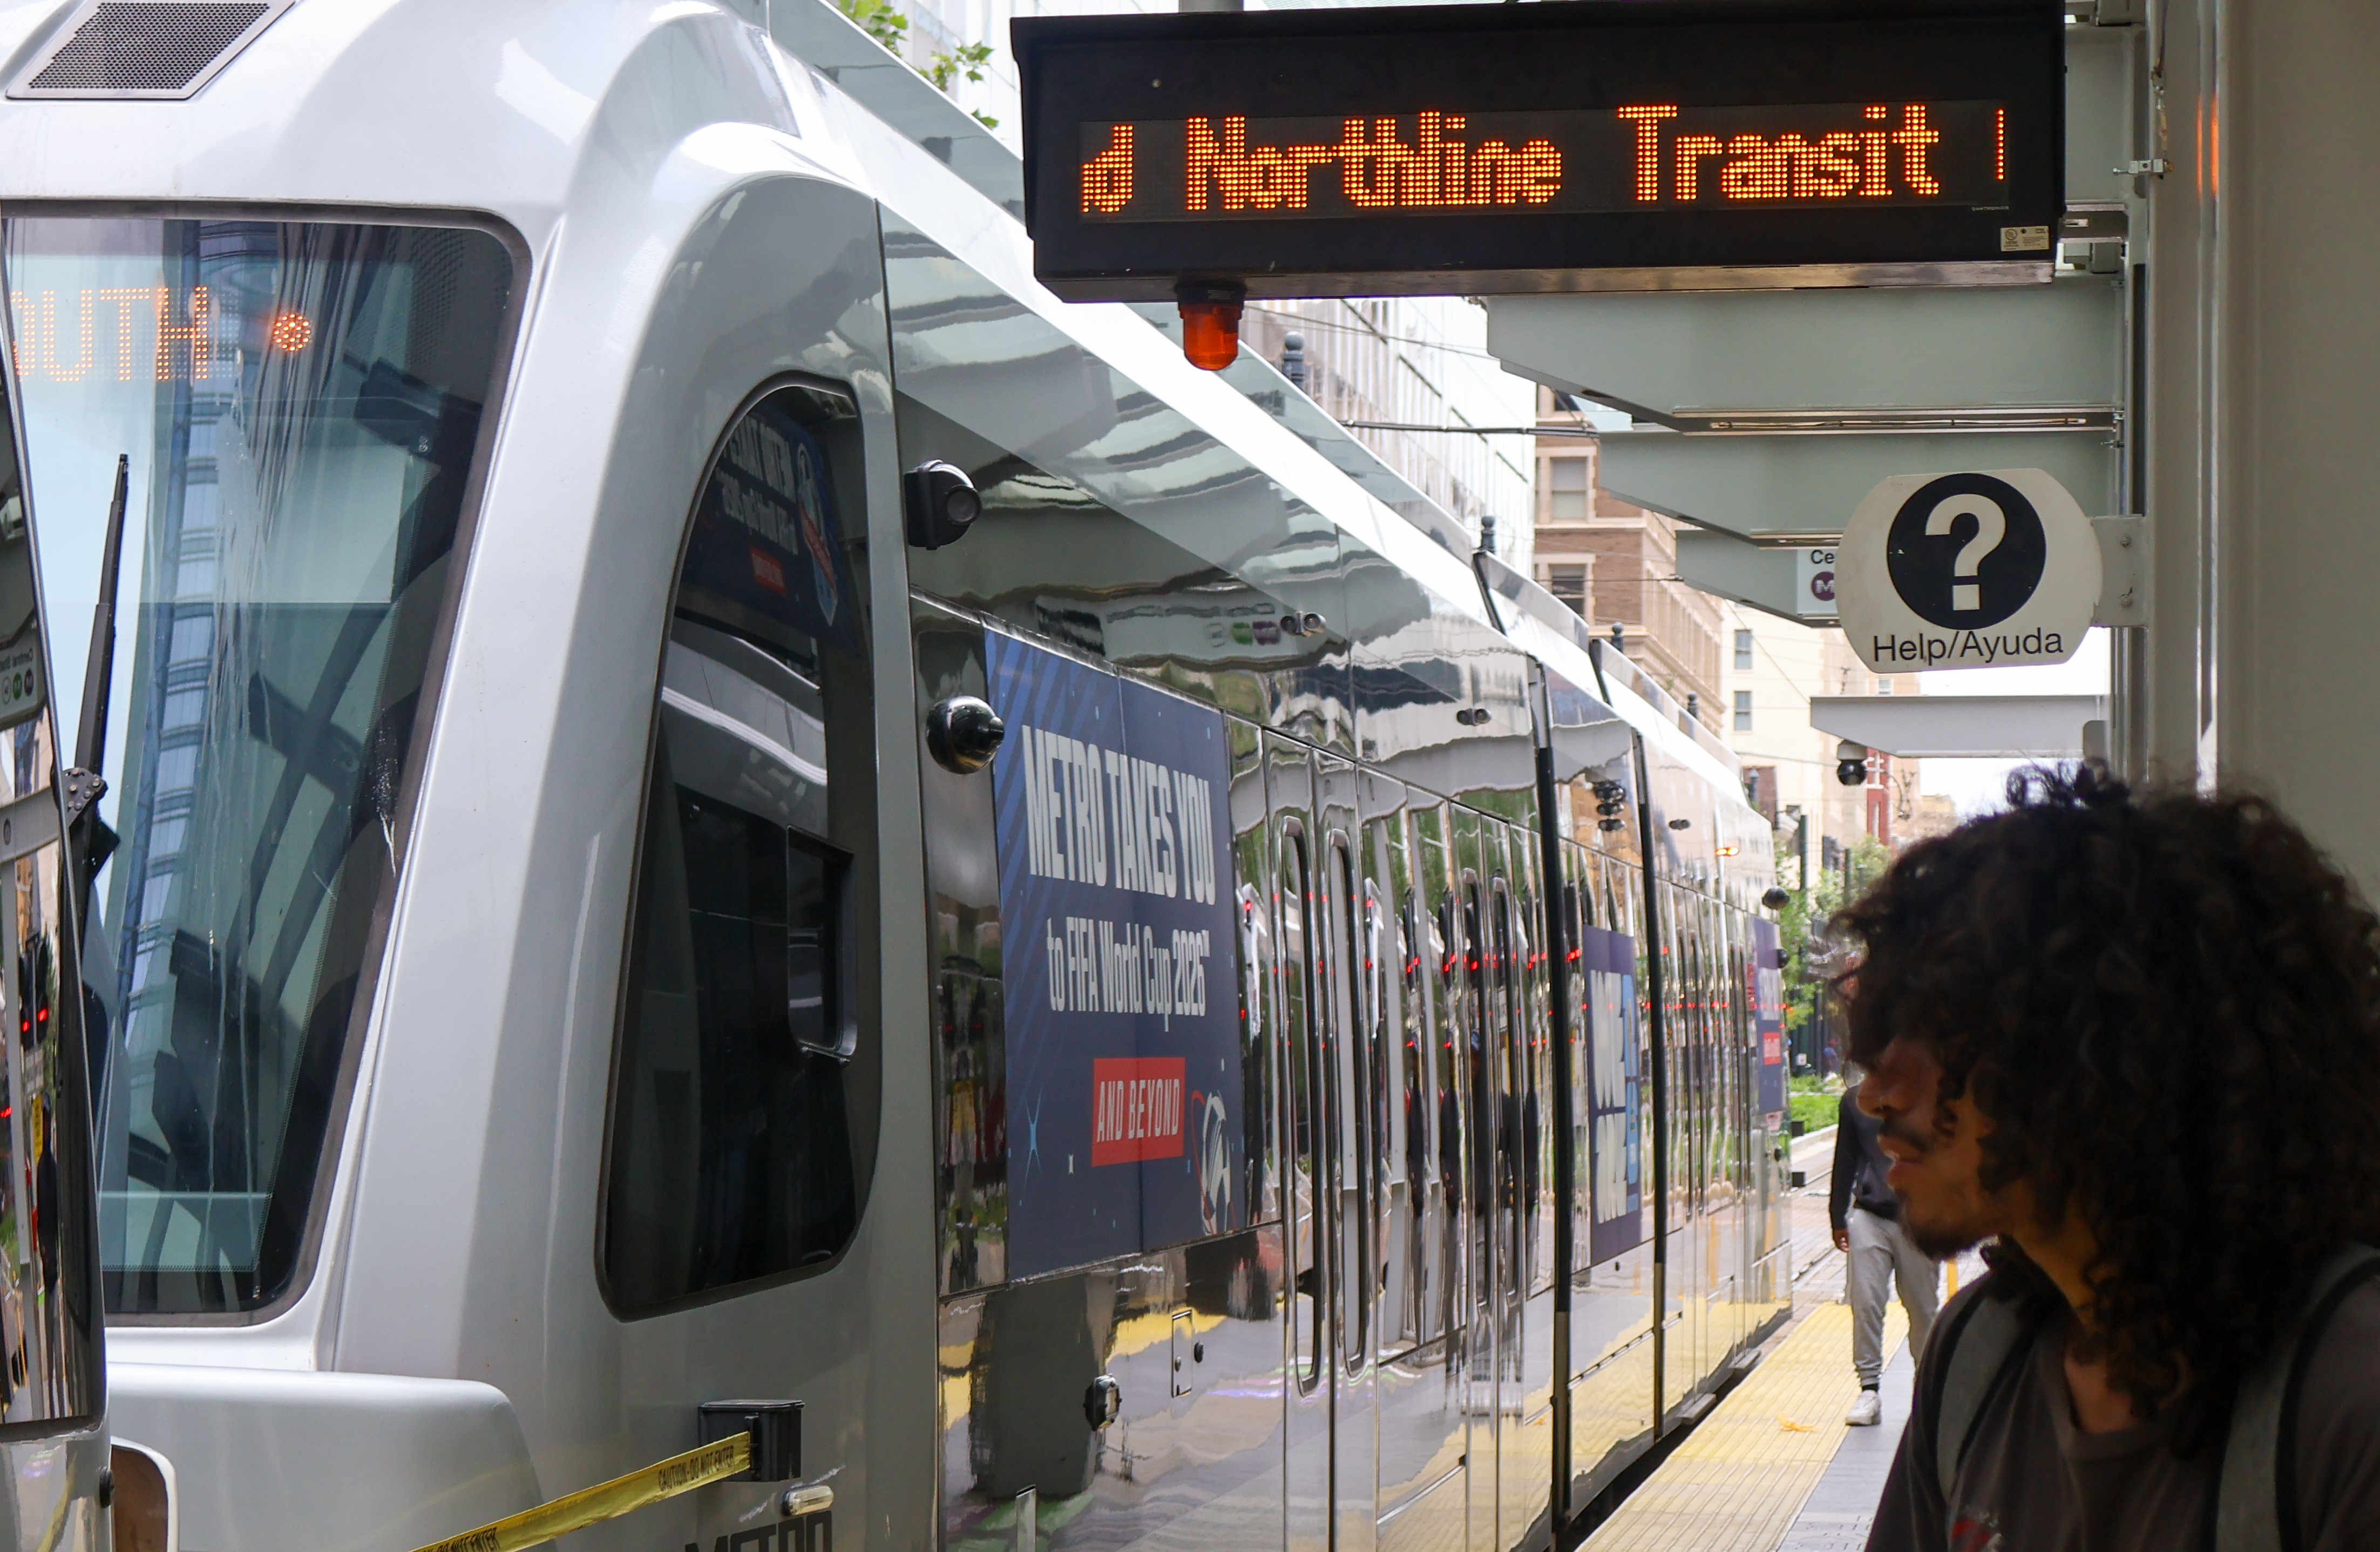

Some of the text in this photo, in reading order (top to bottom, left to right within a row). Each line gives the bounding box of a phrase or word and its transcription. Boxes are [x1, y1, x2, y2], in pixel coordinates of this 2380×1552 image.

[1186, 111, 1561, 211] Northline
[1617, 104, 1941, 201] Transit
[1874, 627, 2064, 666] Help/Ayuda
[1022, 724, 1216, 905] METRO TAKES YOU
[1047, 917, 1066, 1012] to
[1066, 916, 1099, 1012] FIFA
[1099, 920, 1143, 1013] World
[1143, 925, 1172, 1032] Cup
[1096, 1078, 1181, 1143] AND BEYOND
